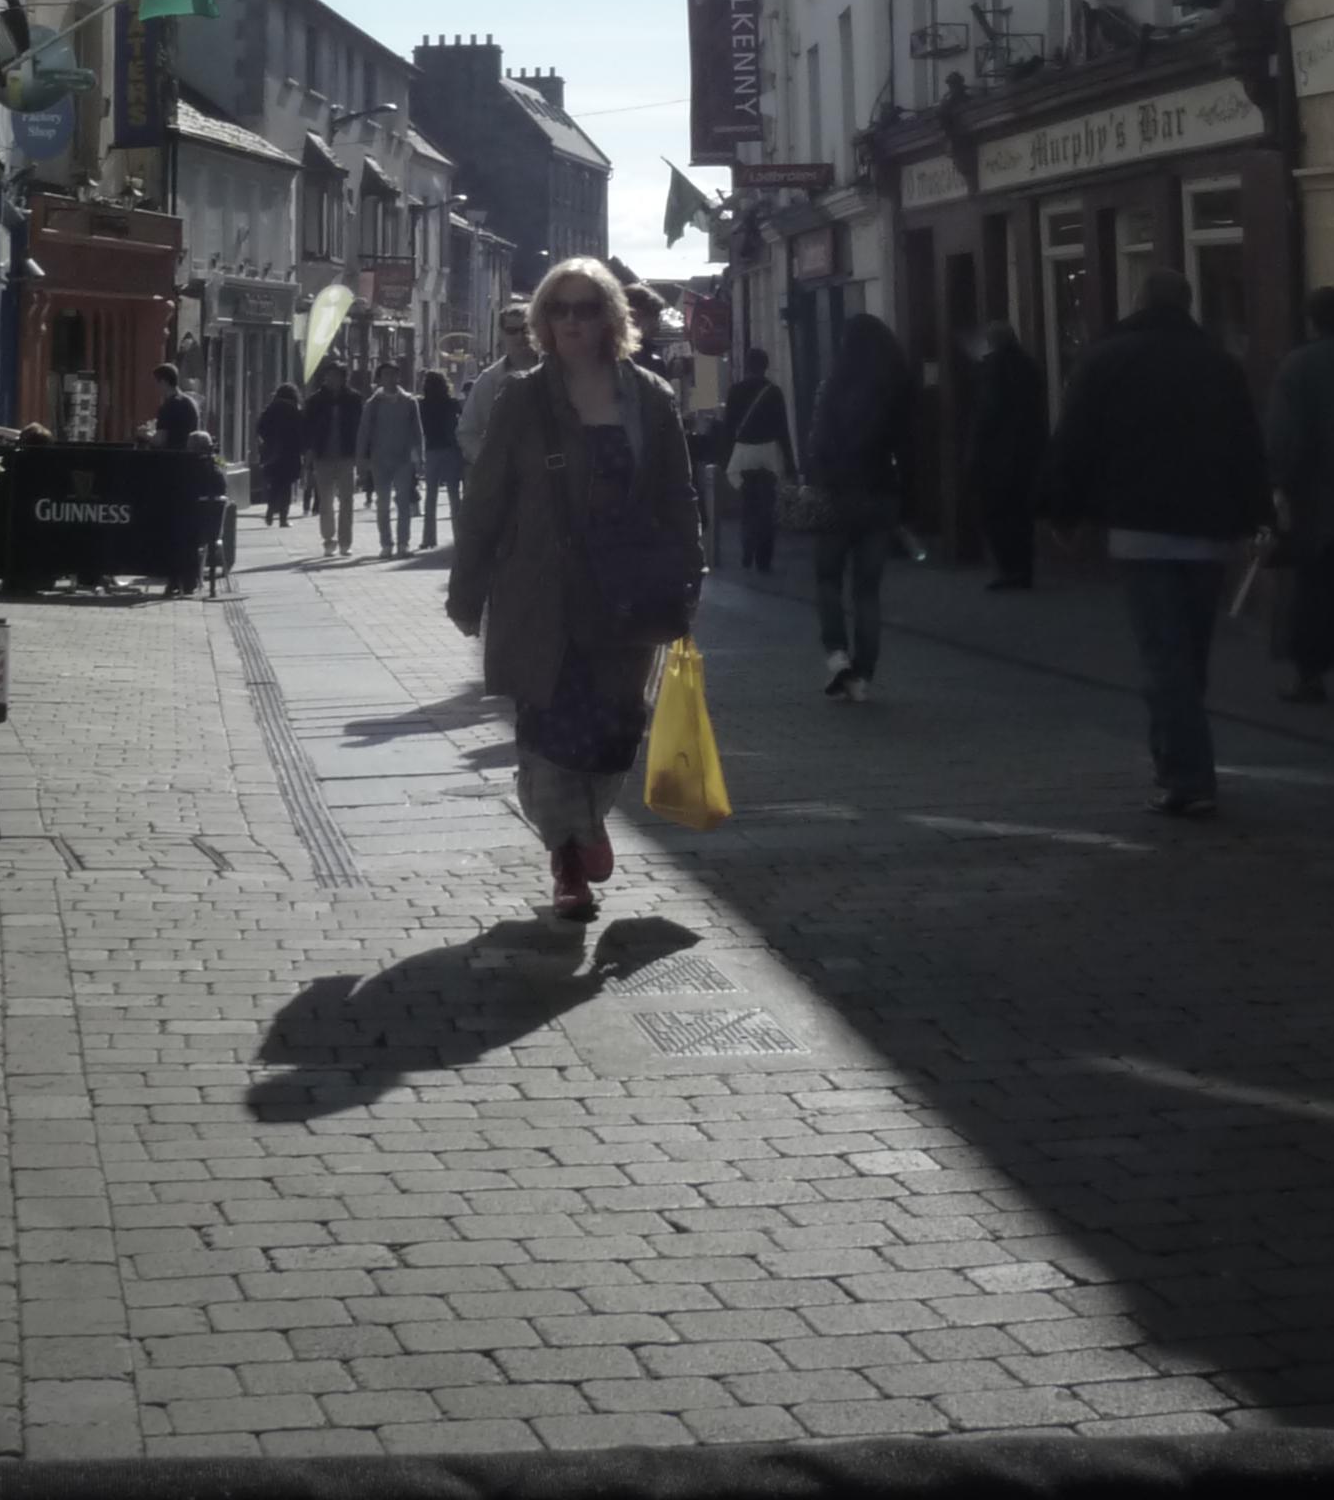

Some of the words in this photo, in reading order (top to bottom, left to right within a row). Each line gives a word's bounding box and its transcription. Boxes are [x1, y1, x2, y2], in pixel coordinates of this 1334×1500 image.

[1029, 111, 1127, 172] Murphy's
[1137, 101, 1187, 152] Bar
[34, 497, 131, 525] GUINNESS
